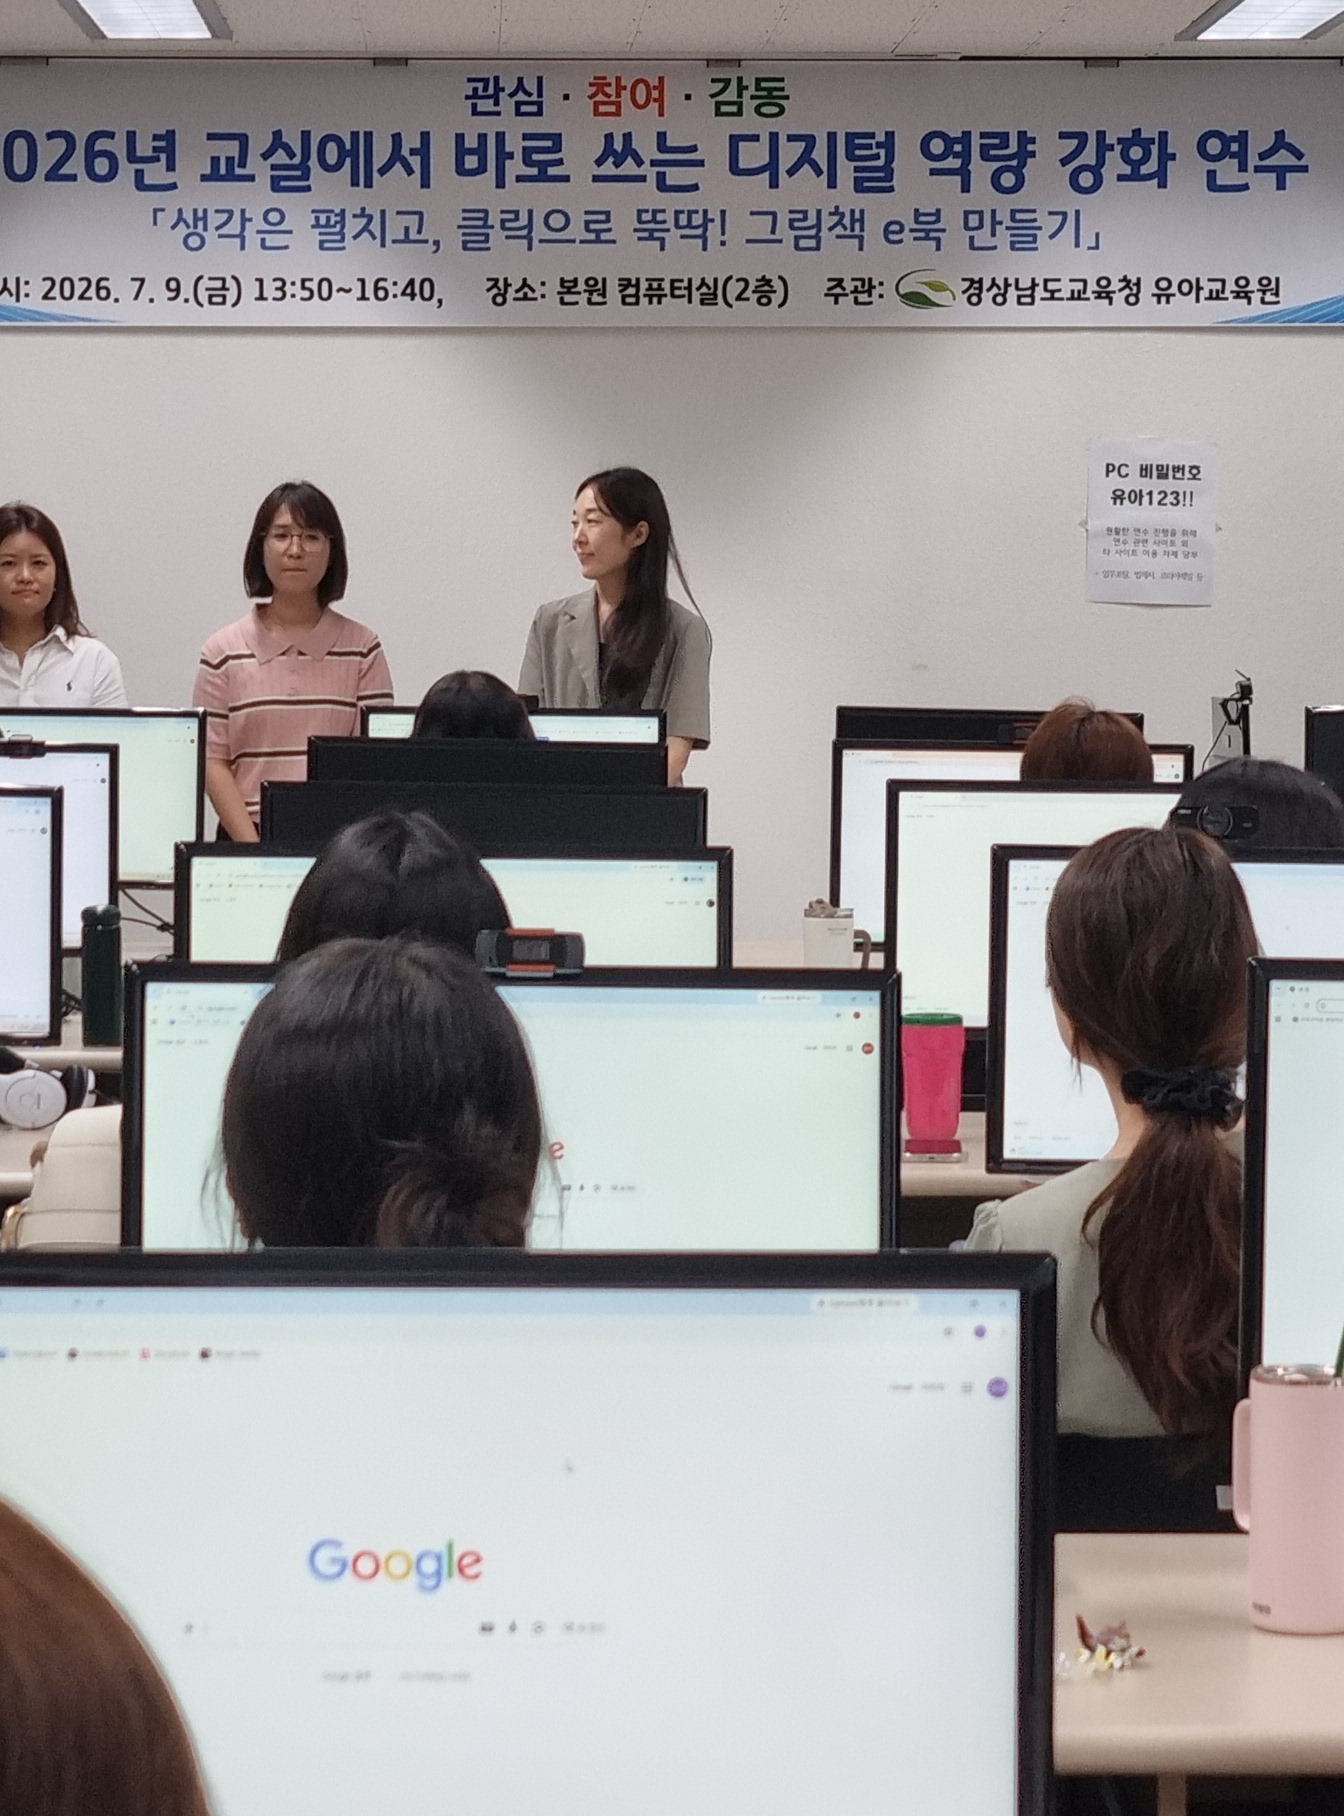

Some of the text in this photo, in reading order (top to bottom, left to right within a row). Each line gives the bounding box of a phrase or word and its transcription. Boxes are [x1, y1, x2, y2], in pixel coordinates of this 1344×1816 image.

[464, 74, 544, 118] 관심
[586, 75, 665, 118] 참여
[708, 75, 791, 119] 감동
[199, 128, 431, 194] 교실에서
[454, 130, 571, 190] 바로
[591, 130, 706, 194] 쓰는
[728, 130, 896, 194] 디지털
[919, 129, 1037, 195] 역량
[1057, 127, 1177, 195] 강화
[1196, 128, 1310, 193] 연수
[310, 206, 441, 255] 펼치고,
[456, 208, 617, 252] 클릭으로
[632, 208, 727, 252] 뚝딱!
[745, 207, 865, 252] 그림책
[882, 207, 947, 252] e북
[41, 276, 120, 304] 2026.
[130, 277, 155, 304] 7.
[164, 274, 242, 308] 9.(금)
[254, 276, 444, 310] 13:50~16:40,
[485, 276, 547, 307] 장소:
[556, 276, 608, 307] 본원
[617, 274, 789, 309] 컴퓨터실(2층)
[823, 276, 885, 306] 주관:
[960, 274, 1142, 307] 경상남도교육청
[1151, 275, 1281, 306] 유아교육원
[1105, 462, 1202, 481] PC 비밀번호
[1110, 488, 1194, 507] 유아123!!
[1112, 537, 1128, 547] 연수
[1153, 538, 1176, 547] 사이트
[1133, 527, 1149, 536] 연수
[1114, 548, 1138, 557] 사이트
[308, 1539, 484, 1592] Google
